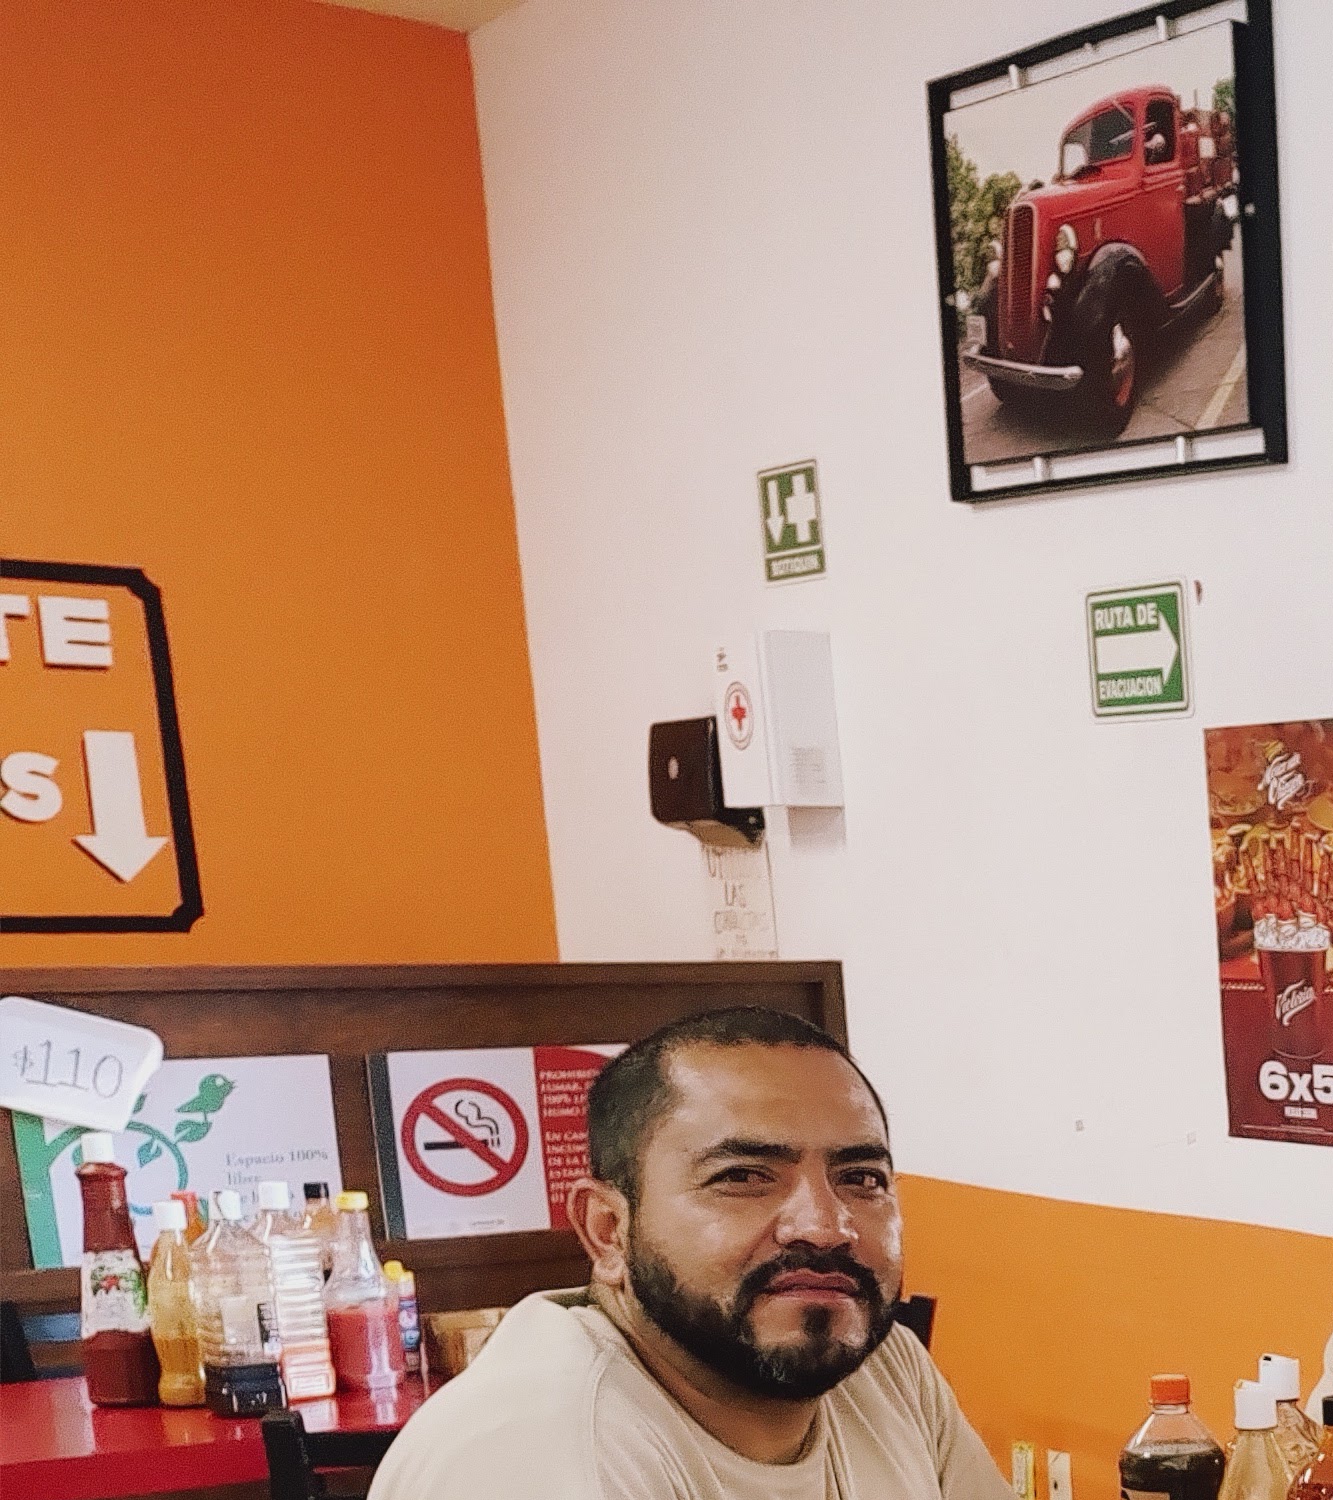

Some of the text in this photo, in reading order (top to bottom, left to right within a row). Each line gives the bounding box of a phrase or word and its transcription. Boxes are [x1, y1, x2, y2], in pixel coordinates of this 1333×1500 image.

[1094, 602, 1158, 631] RUTA DE
[1098, 676, 1163, 700] EVACUACION
[13, 1039, 123, 1098] $110
